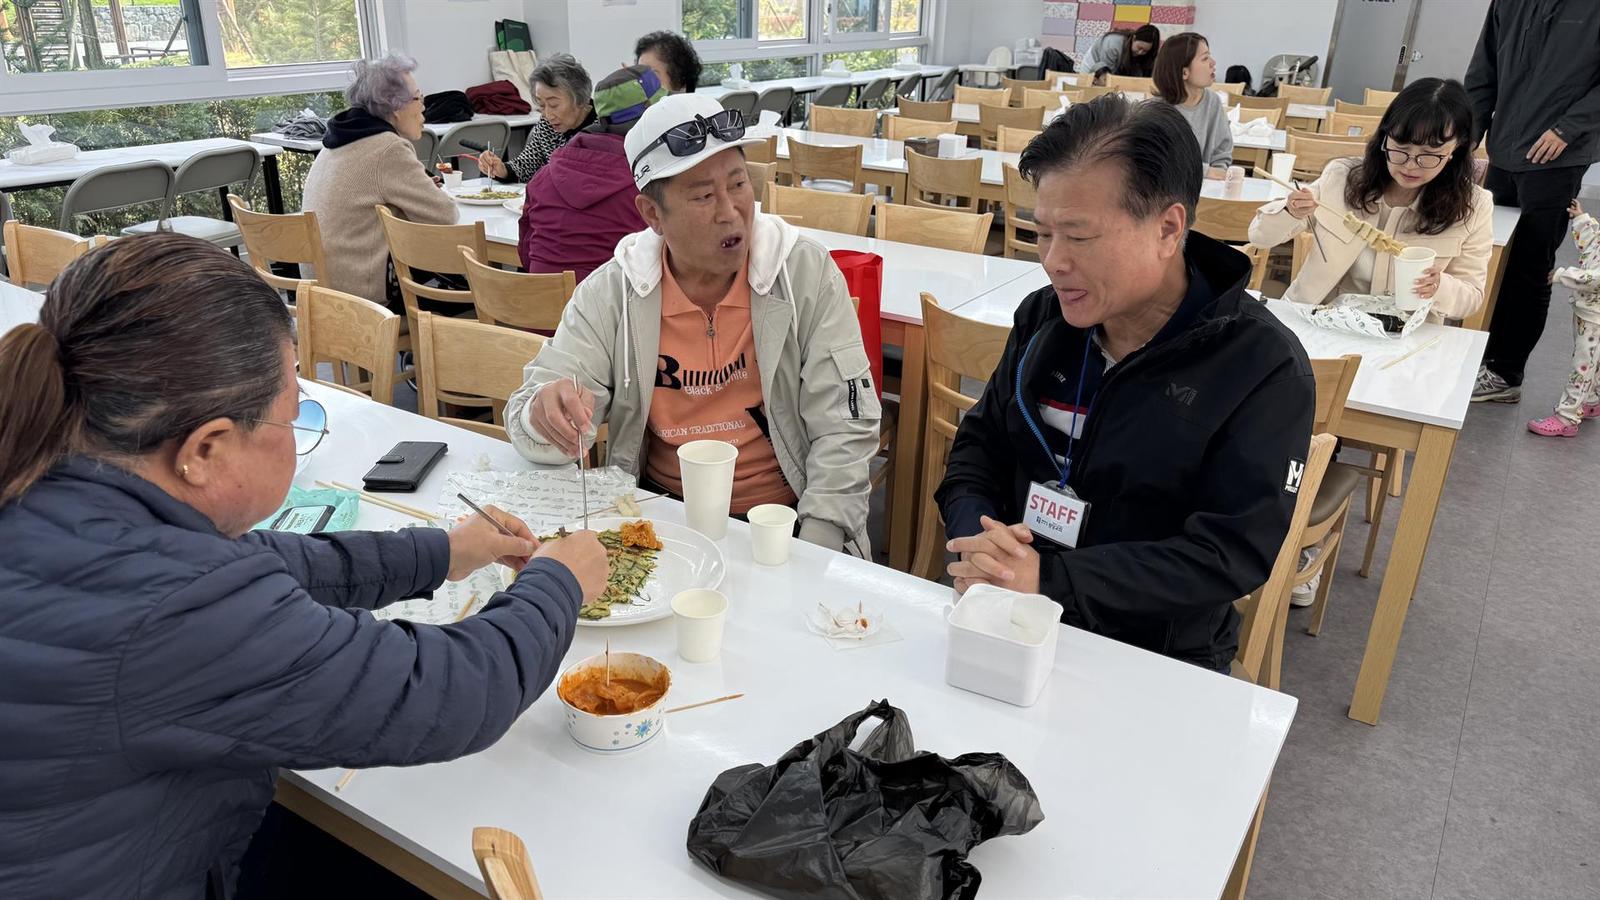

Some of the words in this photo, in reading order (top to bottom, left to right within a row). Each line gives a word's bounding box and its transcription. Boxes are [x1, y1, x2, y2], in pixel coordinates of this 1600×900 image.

[684, 385, 713, 396] Black
[715, 383, 724, 392] &
[689, 420, 745, 435] TRADITIONAL
[1029, 493, 1078, 525] STAFF
